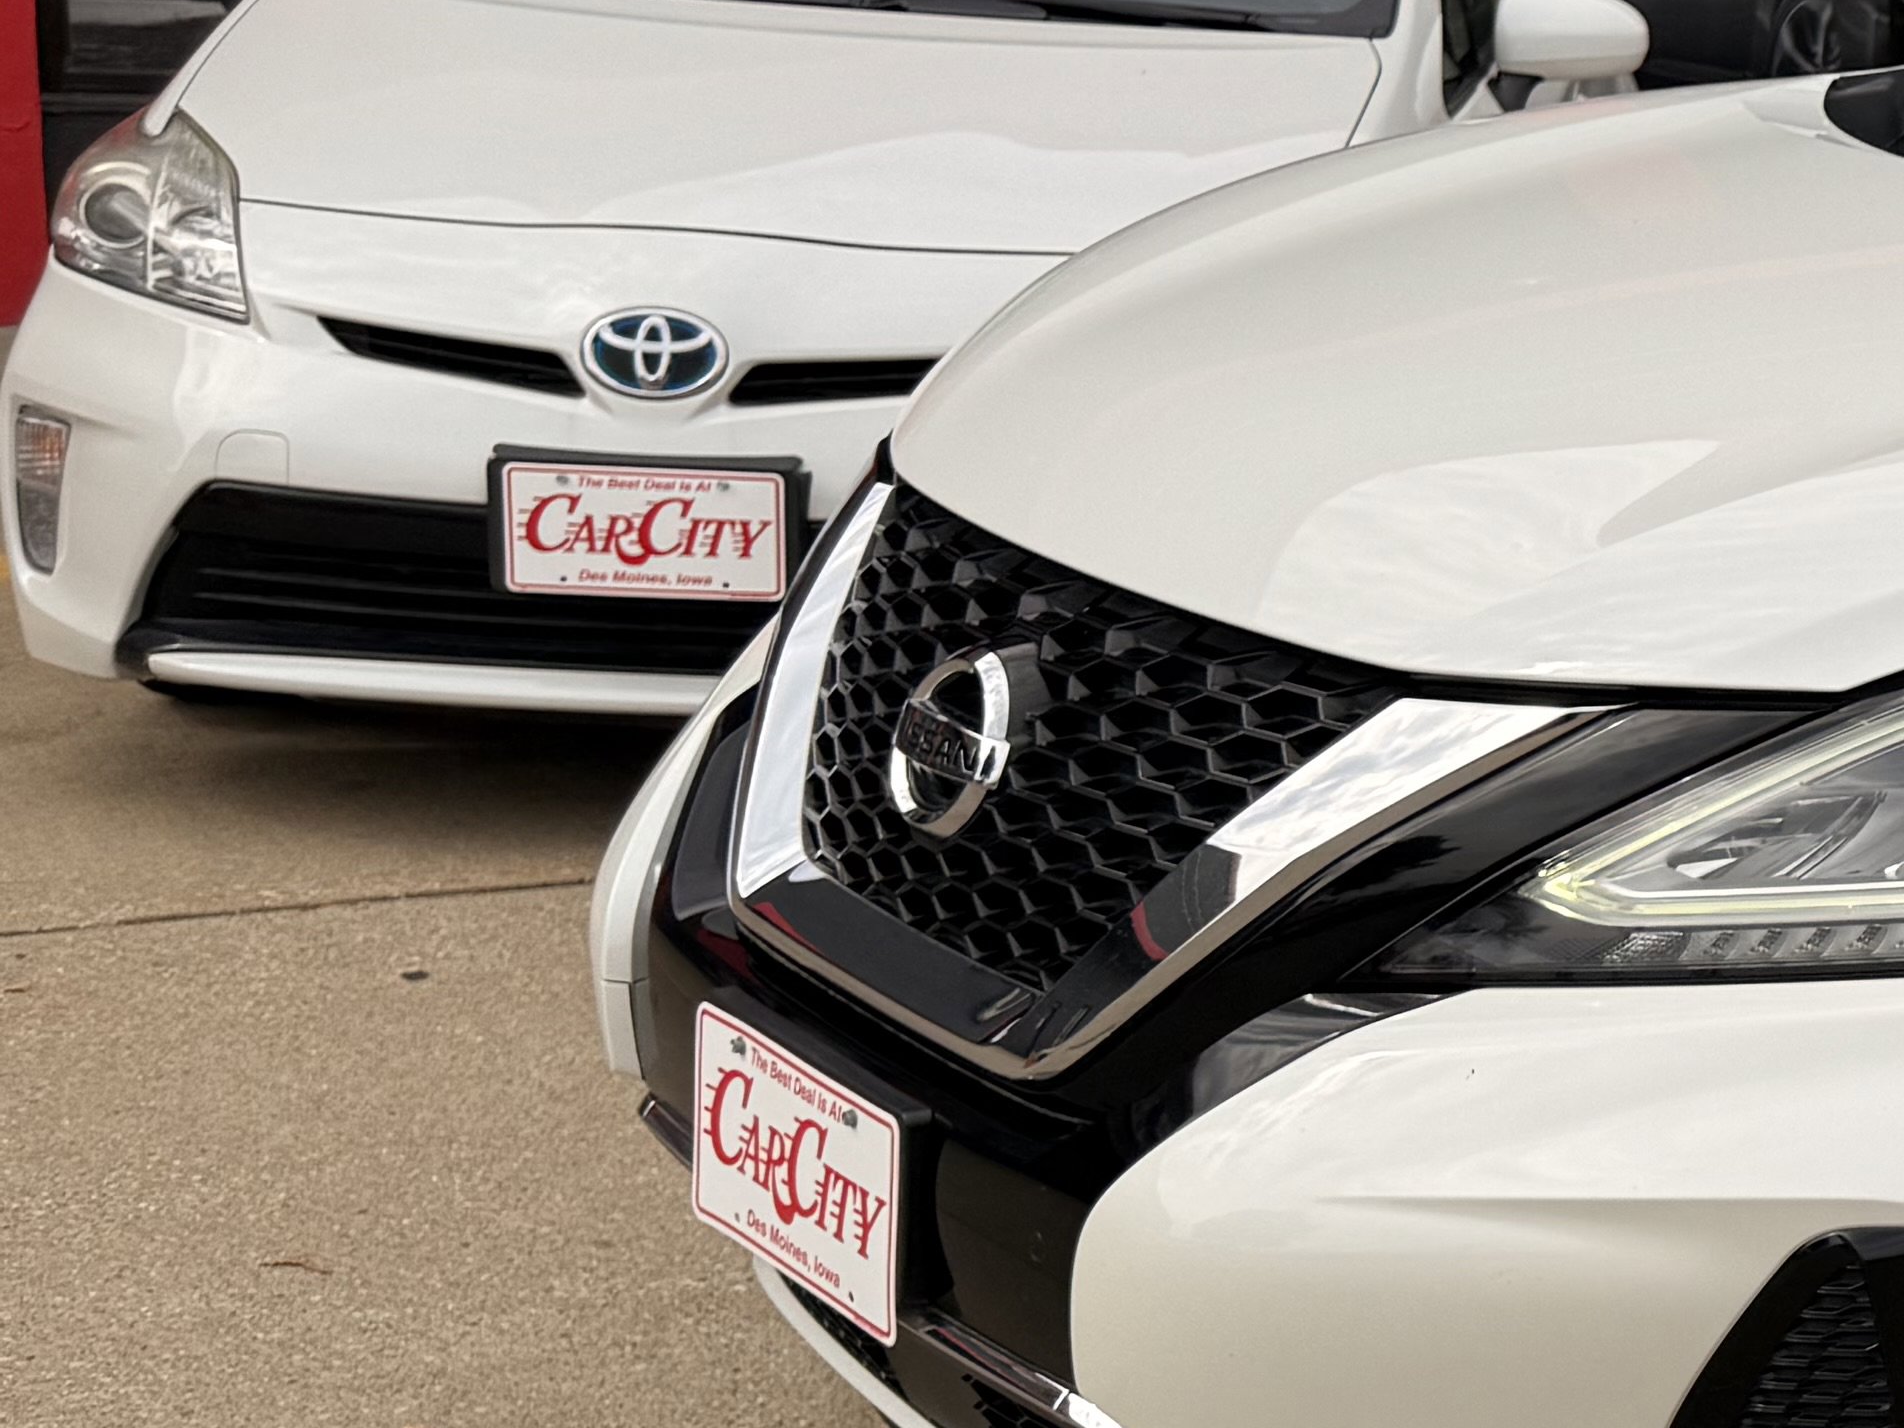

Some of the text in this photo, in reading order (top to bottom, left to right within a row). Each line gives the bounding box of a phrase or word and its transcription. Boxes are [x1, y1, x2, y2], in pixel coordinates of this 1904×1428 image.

[578, 476, 603, 489] The
[607, 477, 640, 491] Best
[643, 478, 676, 492] Deal
[696, 480, 712, 492] At
[578, 569, 713, 587] Des Moines, Iowa
[751, 1046, 768, 1074] The
[769, 1060, 792, 1091] Best
[793, 1076, 816, 1107] Deal
[817, 1092, 828, 1113] Is
[746, 1208, 841, 1289] Des Moines, Iowa
